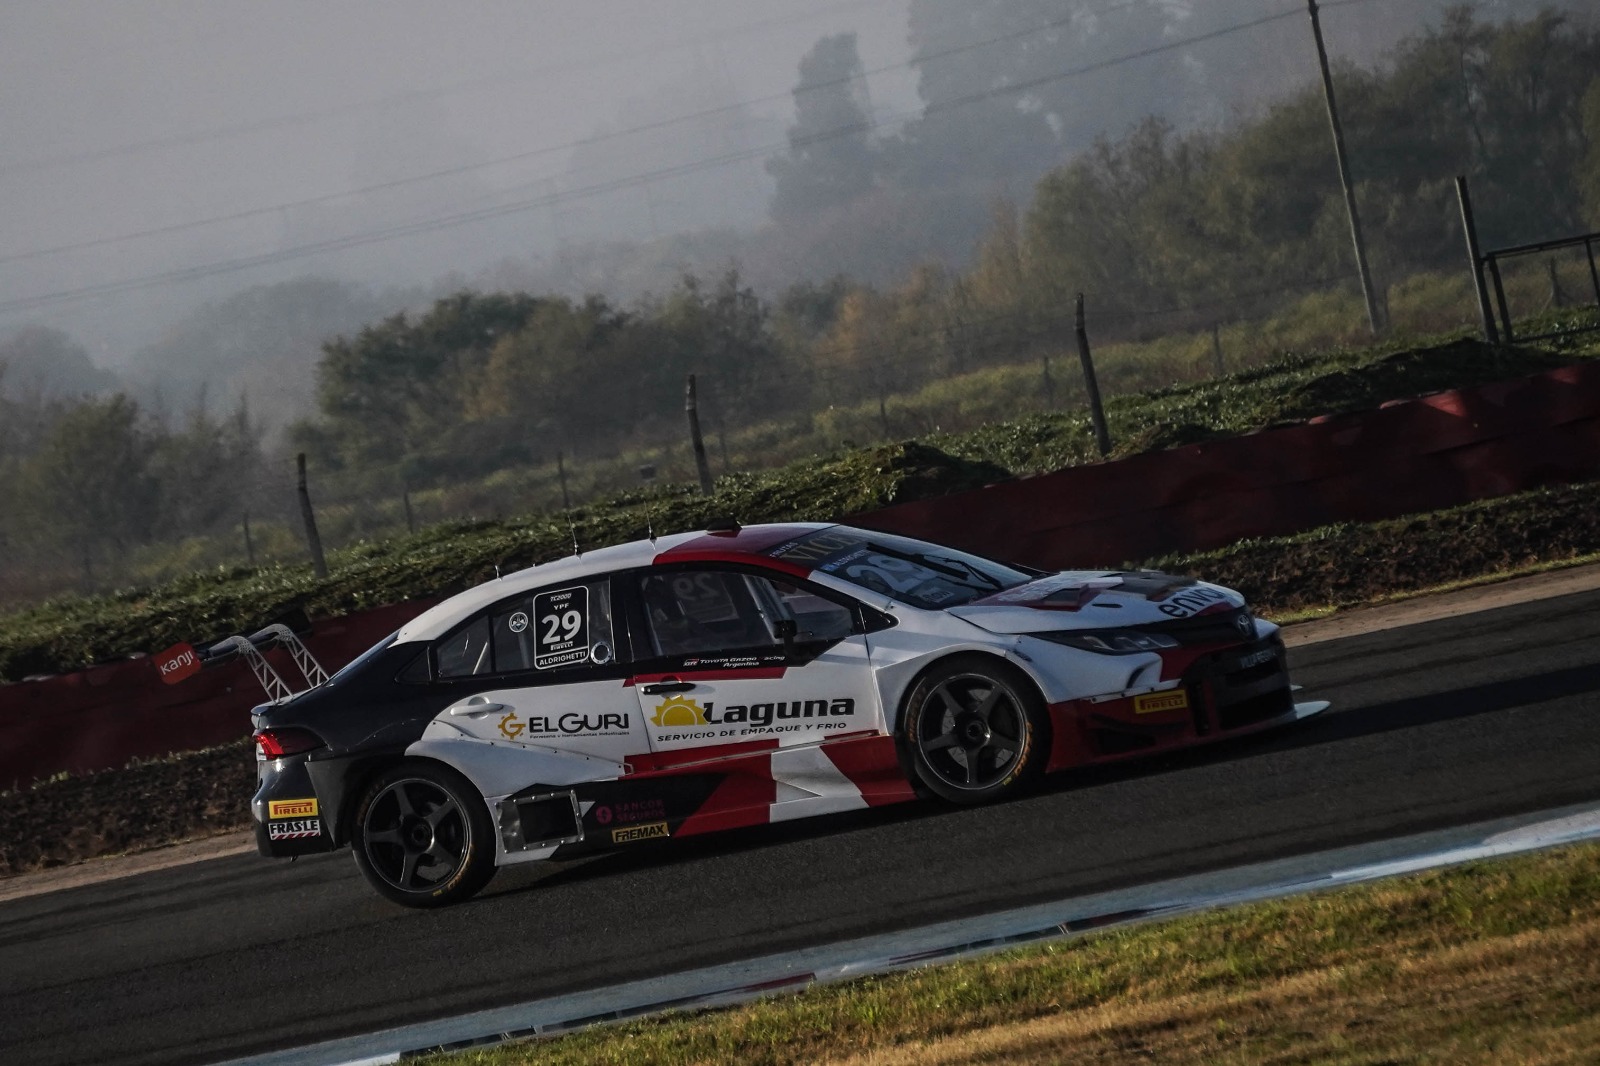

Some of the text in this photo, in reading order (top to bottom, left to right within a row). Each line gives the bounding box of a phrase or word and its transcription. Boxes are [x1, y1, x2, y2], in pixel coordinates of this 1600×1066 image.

[550, 592, 572, 602] TC2000
[541, 610, 581, 645] 29
[550, 640, 574, 651] PIRELLI
[160, 650, 194, 675] kanji
[539, 651, 586, 666] ALDRIGHETTI
[723, 660, 760, 668] Argentina
[1139, 694, 1184, 711] PIRELLI
[703, 698, 855, 728] Laguna
[657, 722, 847, 742] SERVICIO DE EMPAQUE Y FRIO
[273, 802, 313, 815] PIRELLI
[615, 799, 664, 811] SANCOR
[615, 824, 665, 842] FREMAX
